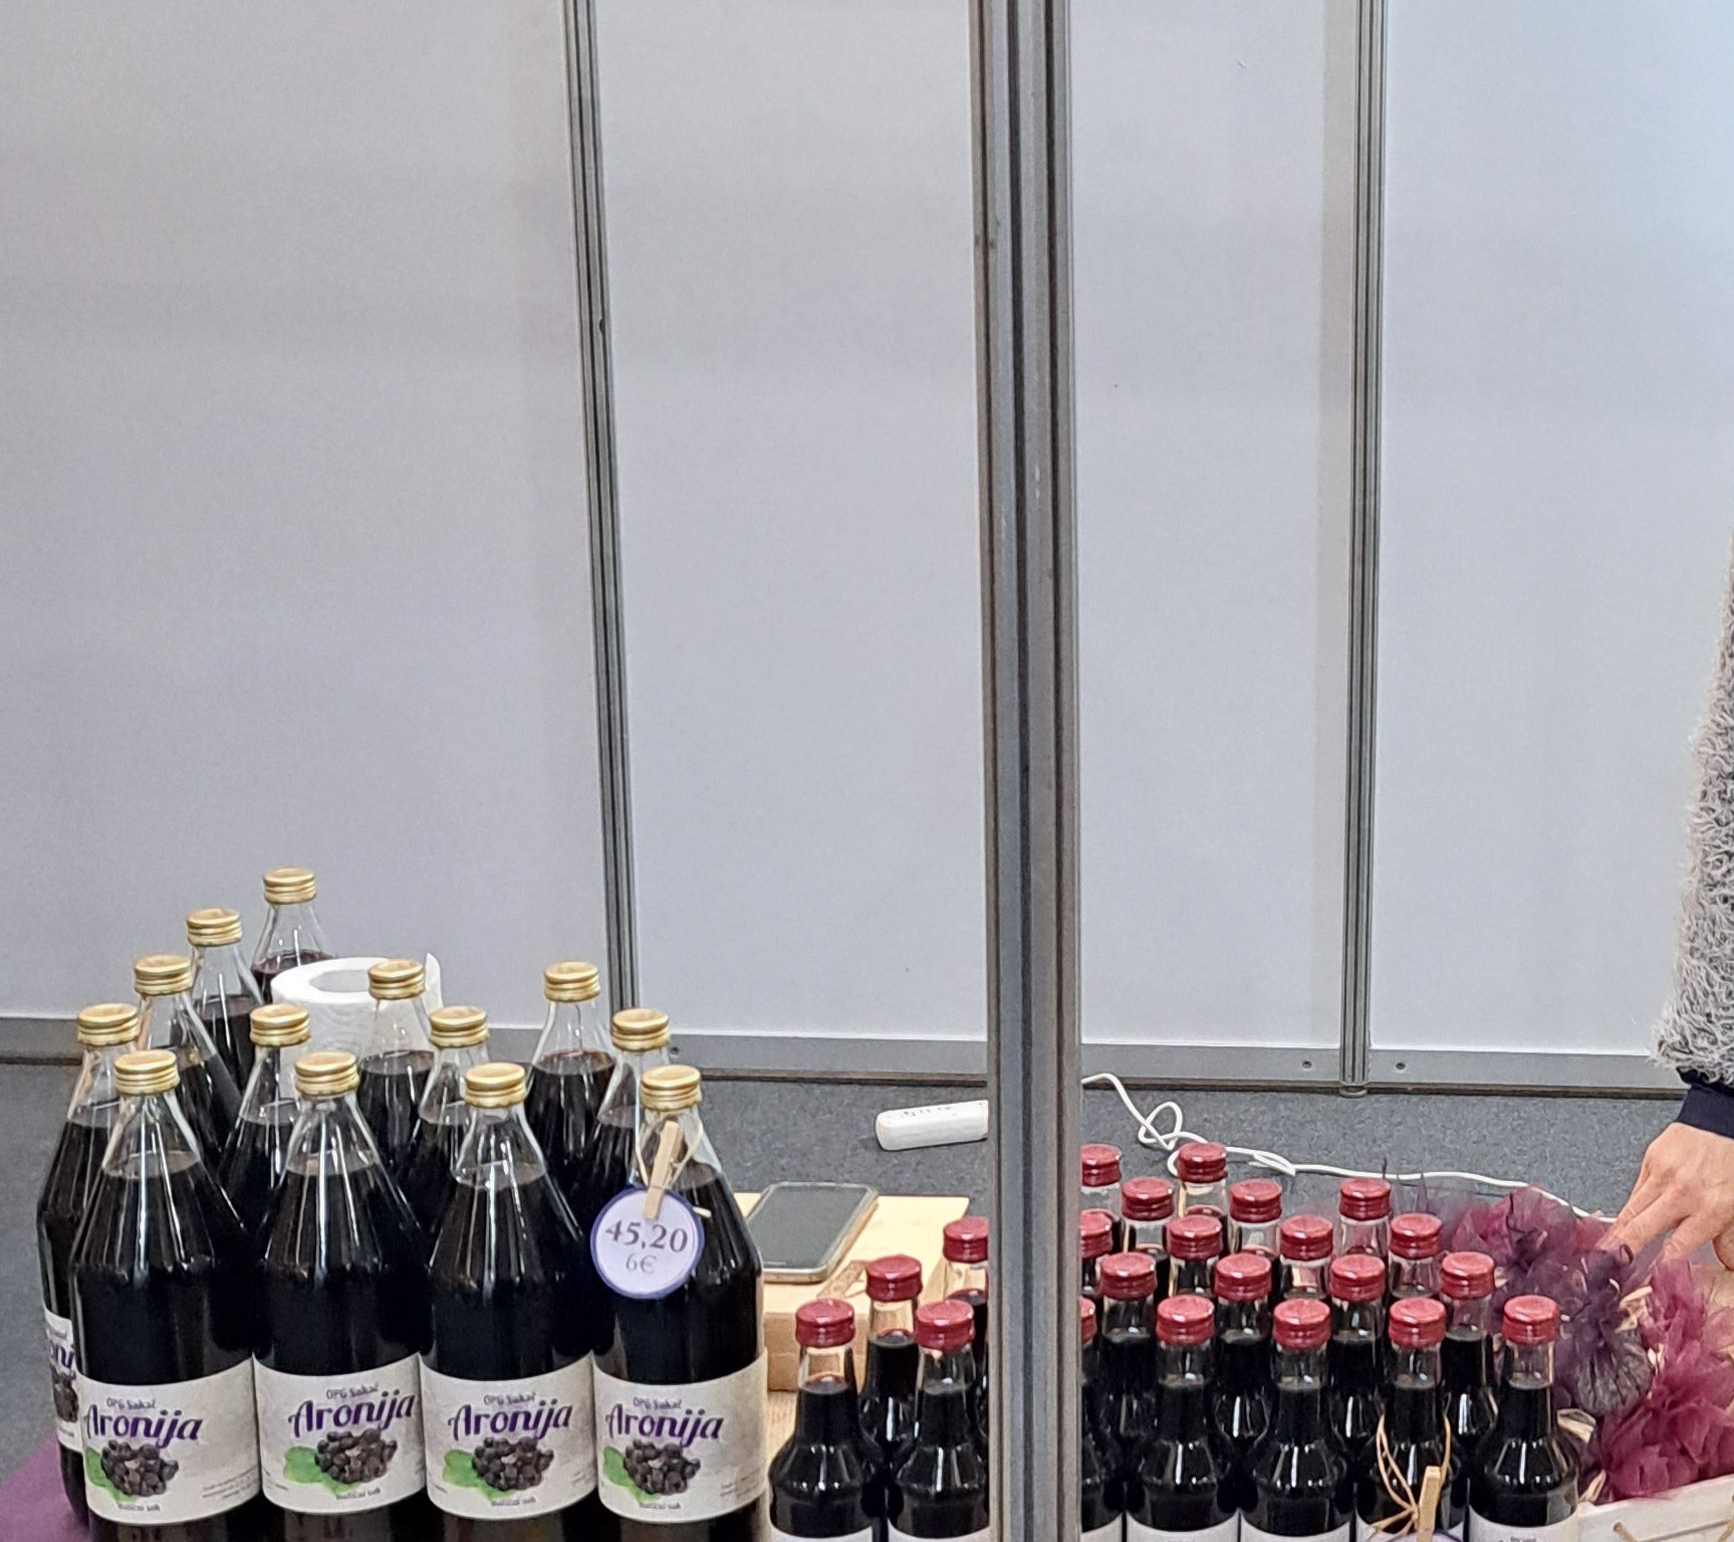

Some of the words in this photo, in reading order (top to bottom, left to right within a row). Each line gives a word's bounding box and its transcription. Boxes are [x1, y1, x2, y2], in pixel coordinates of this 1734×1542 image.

[605, 1219, 689, 1253] 45,20
[625, 1252, 657, 1275] 6€
[83, 1404, 203, 1449] Aronija
[288, 1389, 416, 1438] Aronija
[448, 1398, 573, 1441] Aronija
[605, 1403, 725, 1448] Aronija
